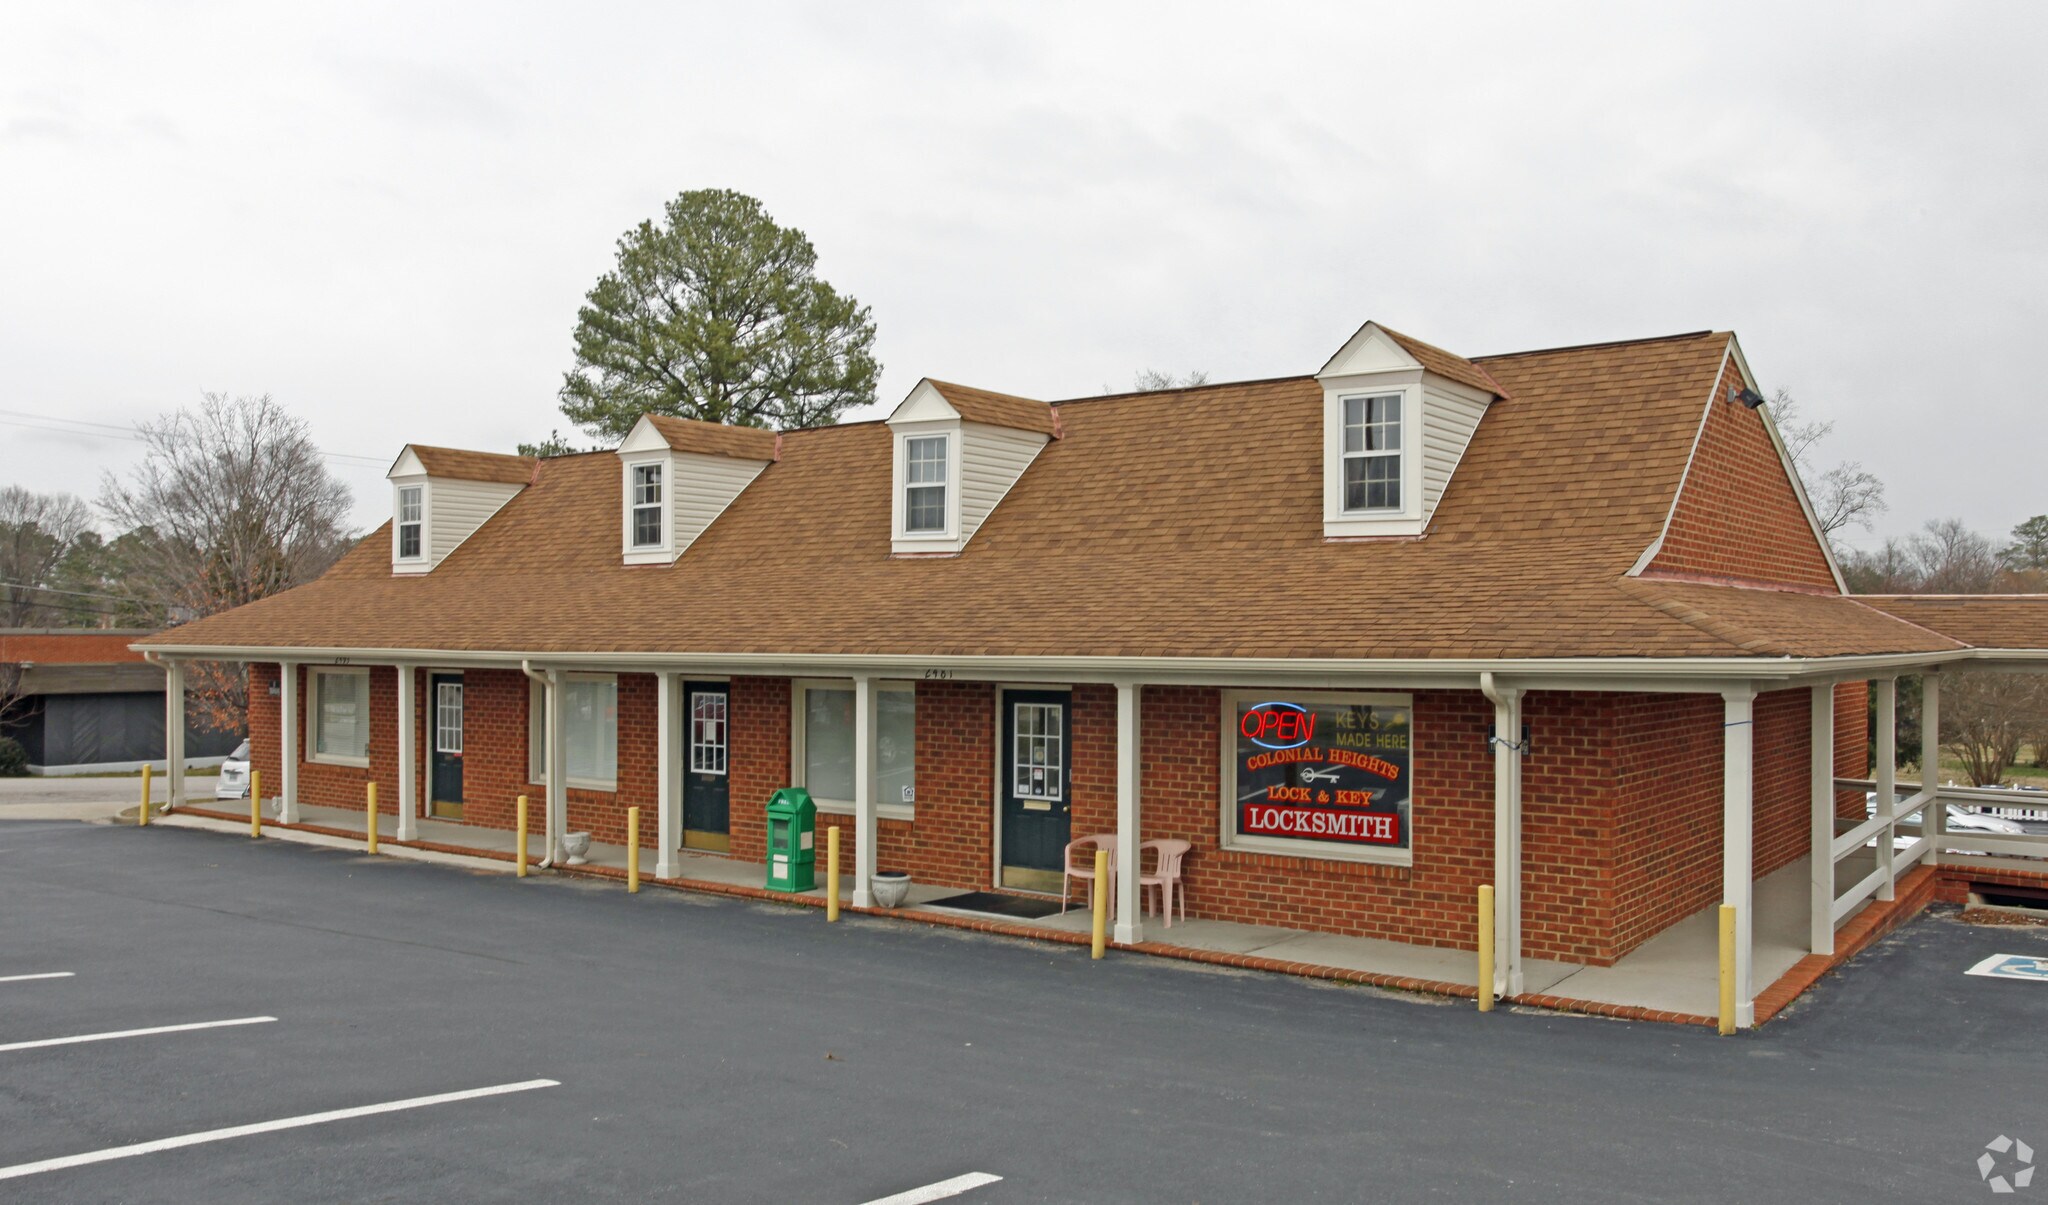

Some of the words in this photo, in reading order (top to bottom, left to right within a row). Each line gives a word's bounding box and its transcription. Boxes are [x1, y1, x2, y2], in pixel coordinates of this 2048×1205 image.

[1241, 710, 1316, 740] OPEN
[1336, 711, 1379, 729] KEYS
[1336, 733, 1371, 747] MADE
[1376, 734, 1407, 749] HERE
[1247, 747, 1324, 770] COLONIAL
[1328, 748, 1400, 781] HEIGHTS
[1267, 786, 1312, 803] LOCK
[1318, 790, 1330, 804] &
[1335, 790, 1373, 807] KEY
[1250, 808, 1393, 839] LOCKSMITH
